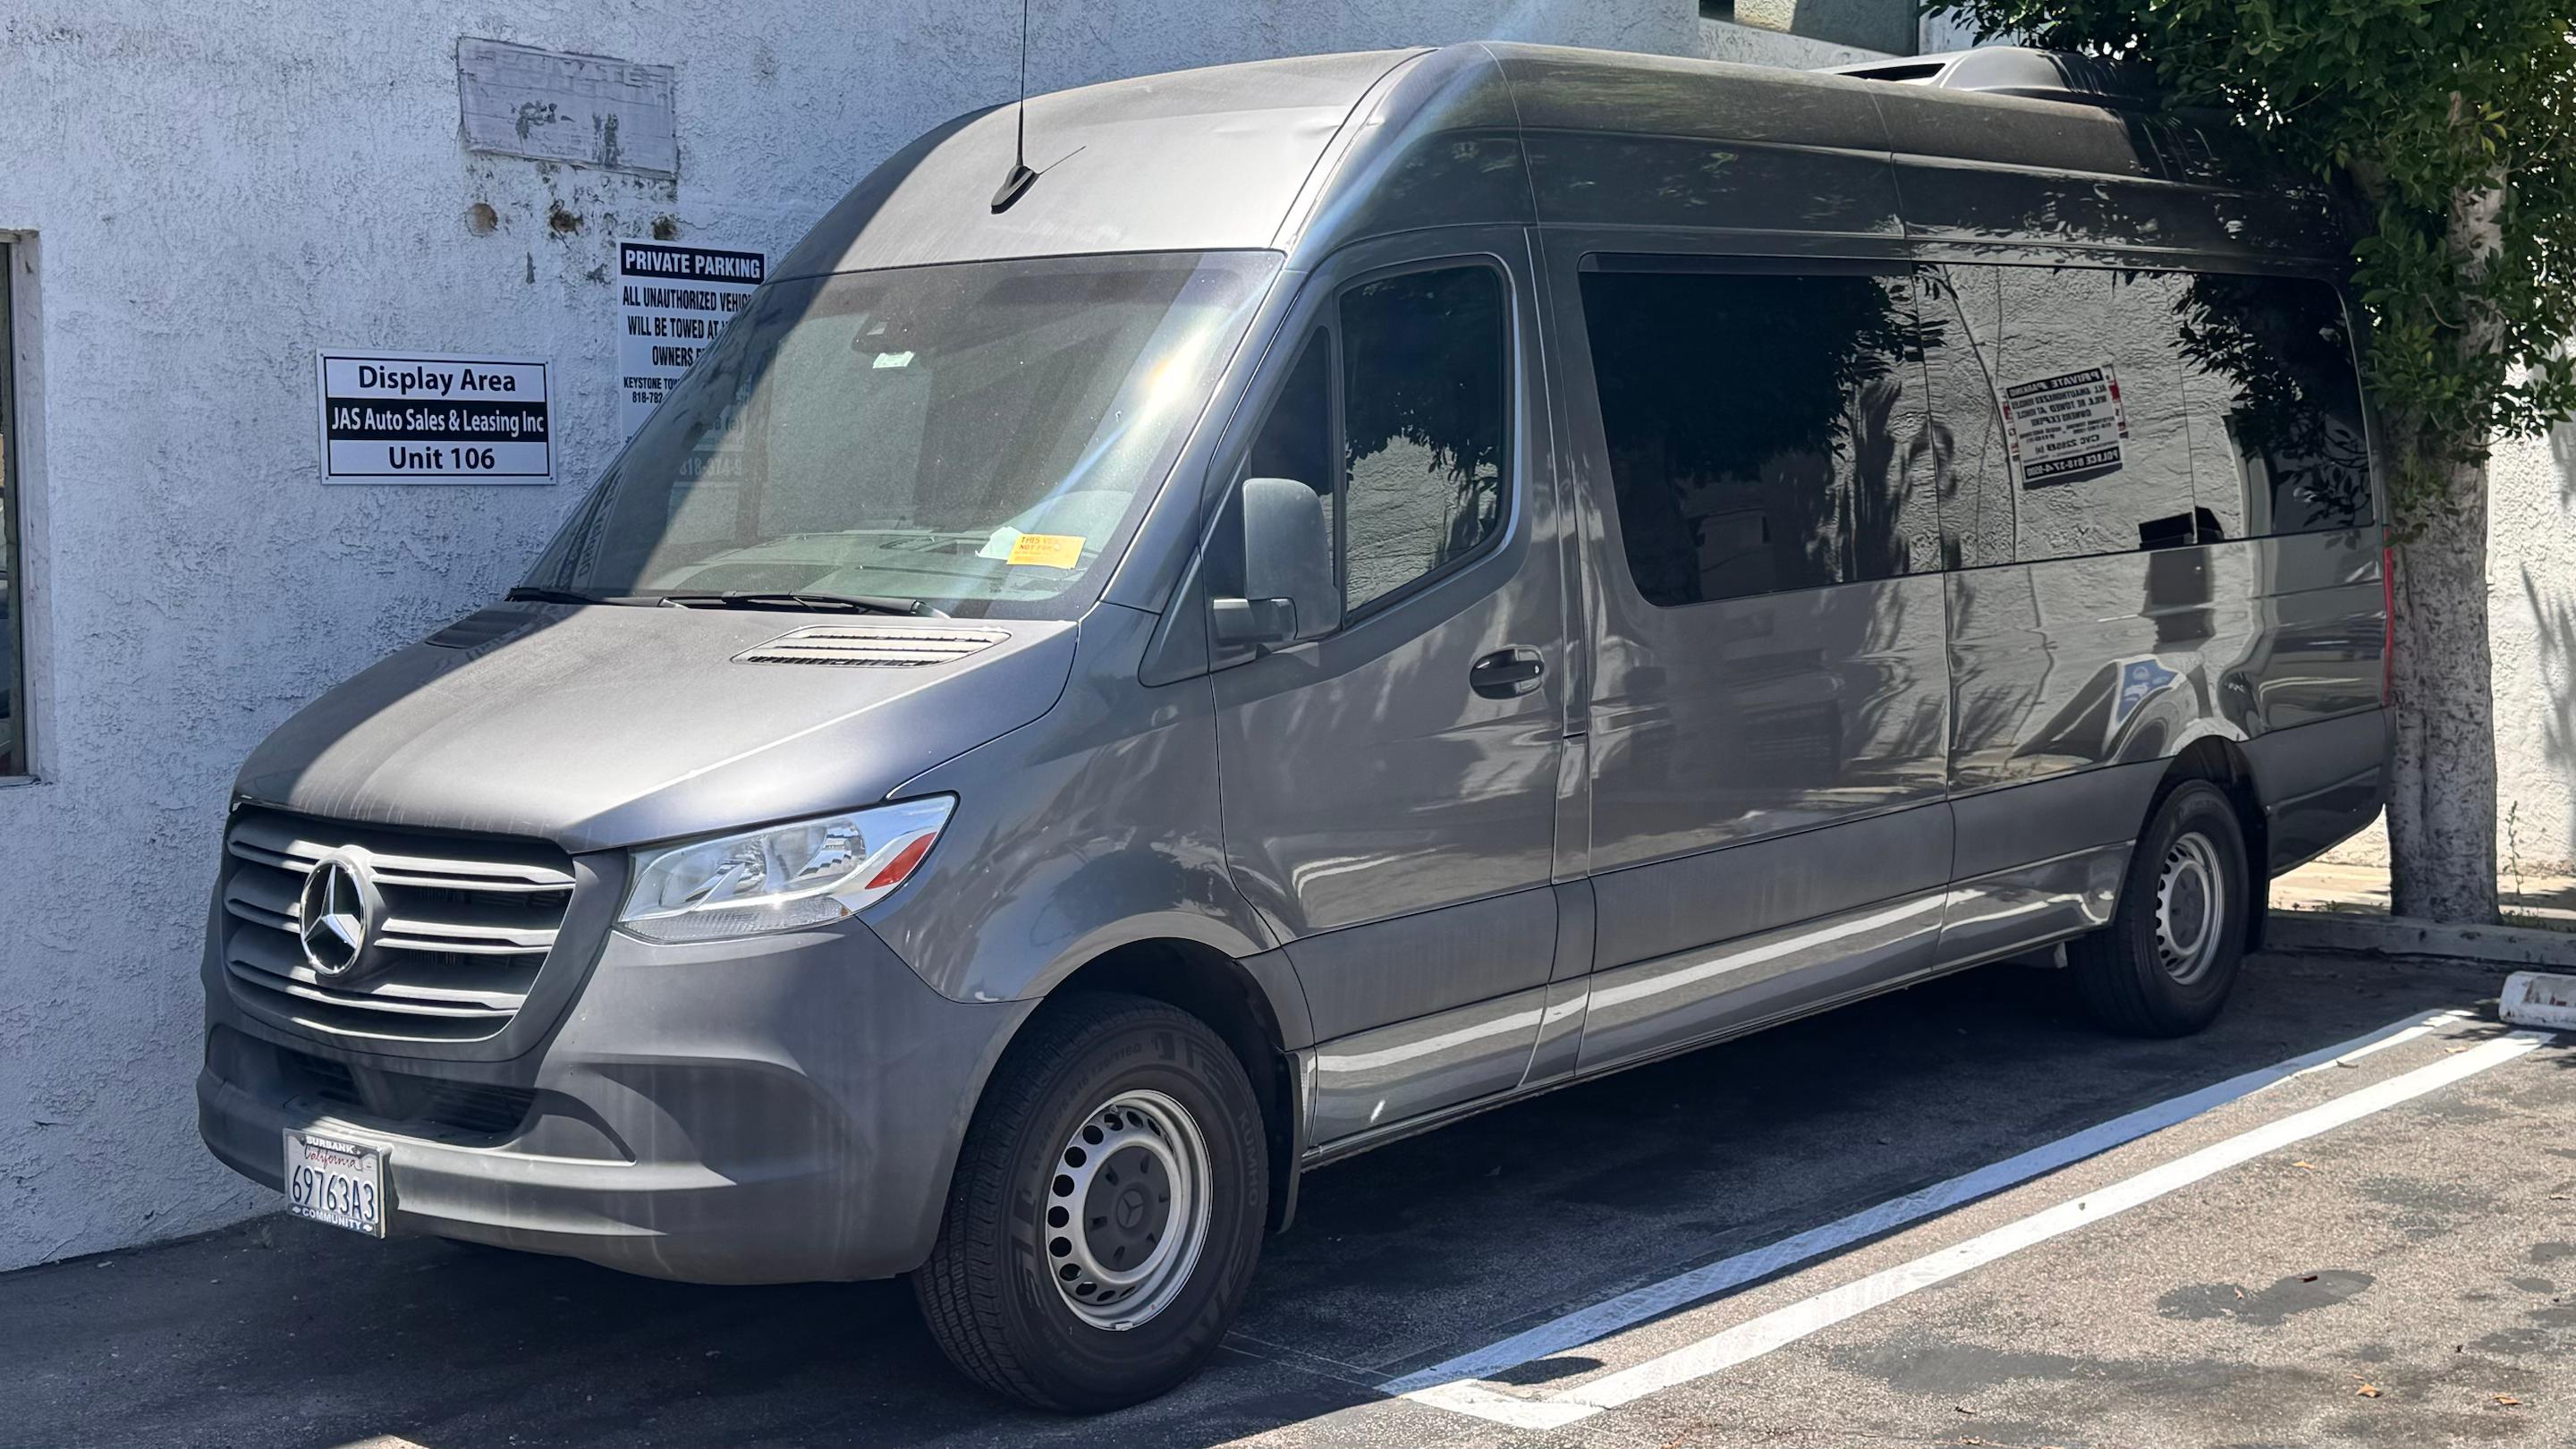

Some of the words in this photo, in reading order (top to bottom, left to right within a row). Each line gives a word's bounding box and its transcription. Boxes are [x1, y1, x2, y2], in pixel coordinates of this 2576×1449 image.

[626, 250, 691, 274] PRIVATE
[695, 255, 760, 279] PARKING
[623, 286, 640, 306] ALL
[644, 287, 716, 311] UNAUTHORIZED
[628, 315, 651, 336] WILL
[655, 318, 667, 337] BE
[670, 318, 705, 339] TOWED
[708, 320, 719, 339] AT
[652, 345, 693, 367] OWNERS
[359, 365, 453, 396] Display
[461, 369, 516, 392] Area
[623, 377, 662, 389] KEYSTONE
[332, 407, 360, 430] JAS
[365, 407, 402, 431] Auto
[406, 408, 445, 431] Sales
[449, 410, 460, 431] &
[463, 410, 520, 437] Leasing
[523, 411, 545, 432] Inc
[388, 446, 444, 469] Unit
[451, 447, 495, 470] 106
[305, 1135, 357, 1155] BURBANK
[1239, 1110, 1258, 1207] KUMHO
[292, 1165, 375, 1222] 69763A3
[302, 1208, 362, 1230] COMMUNITY
